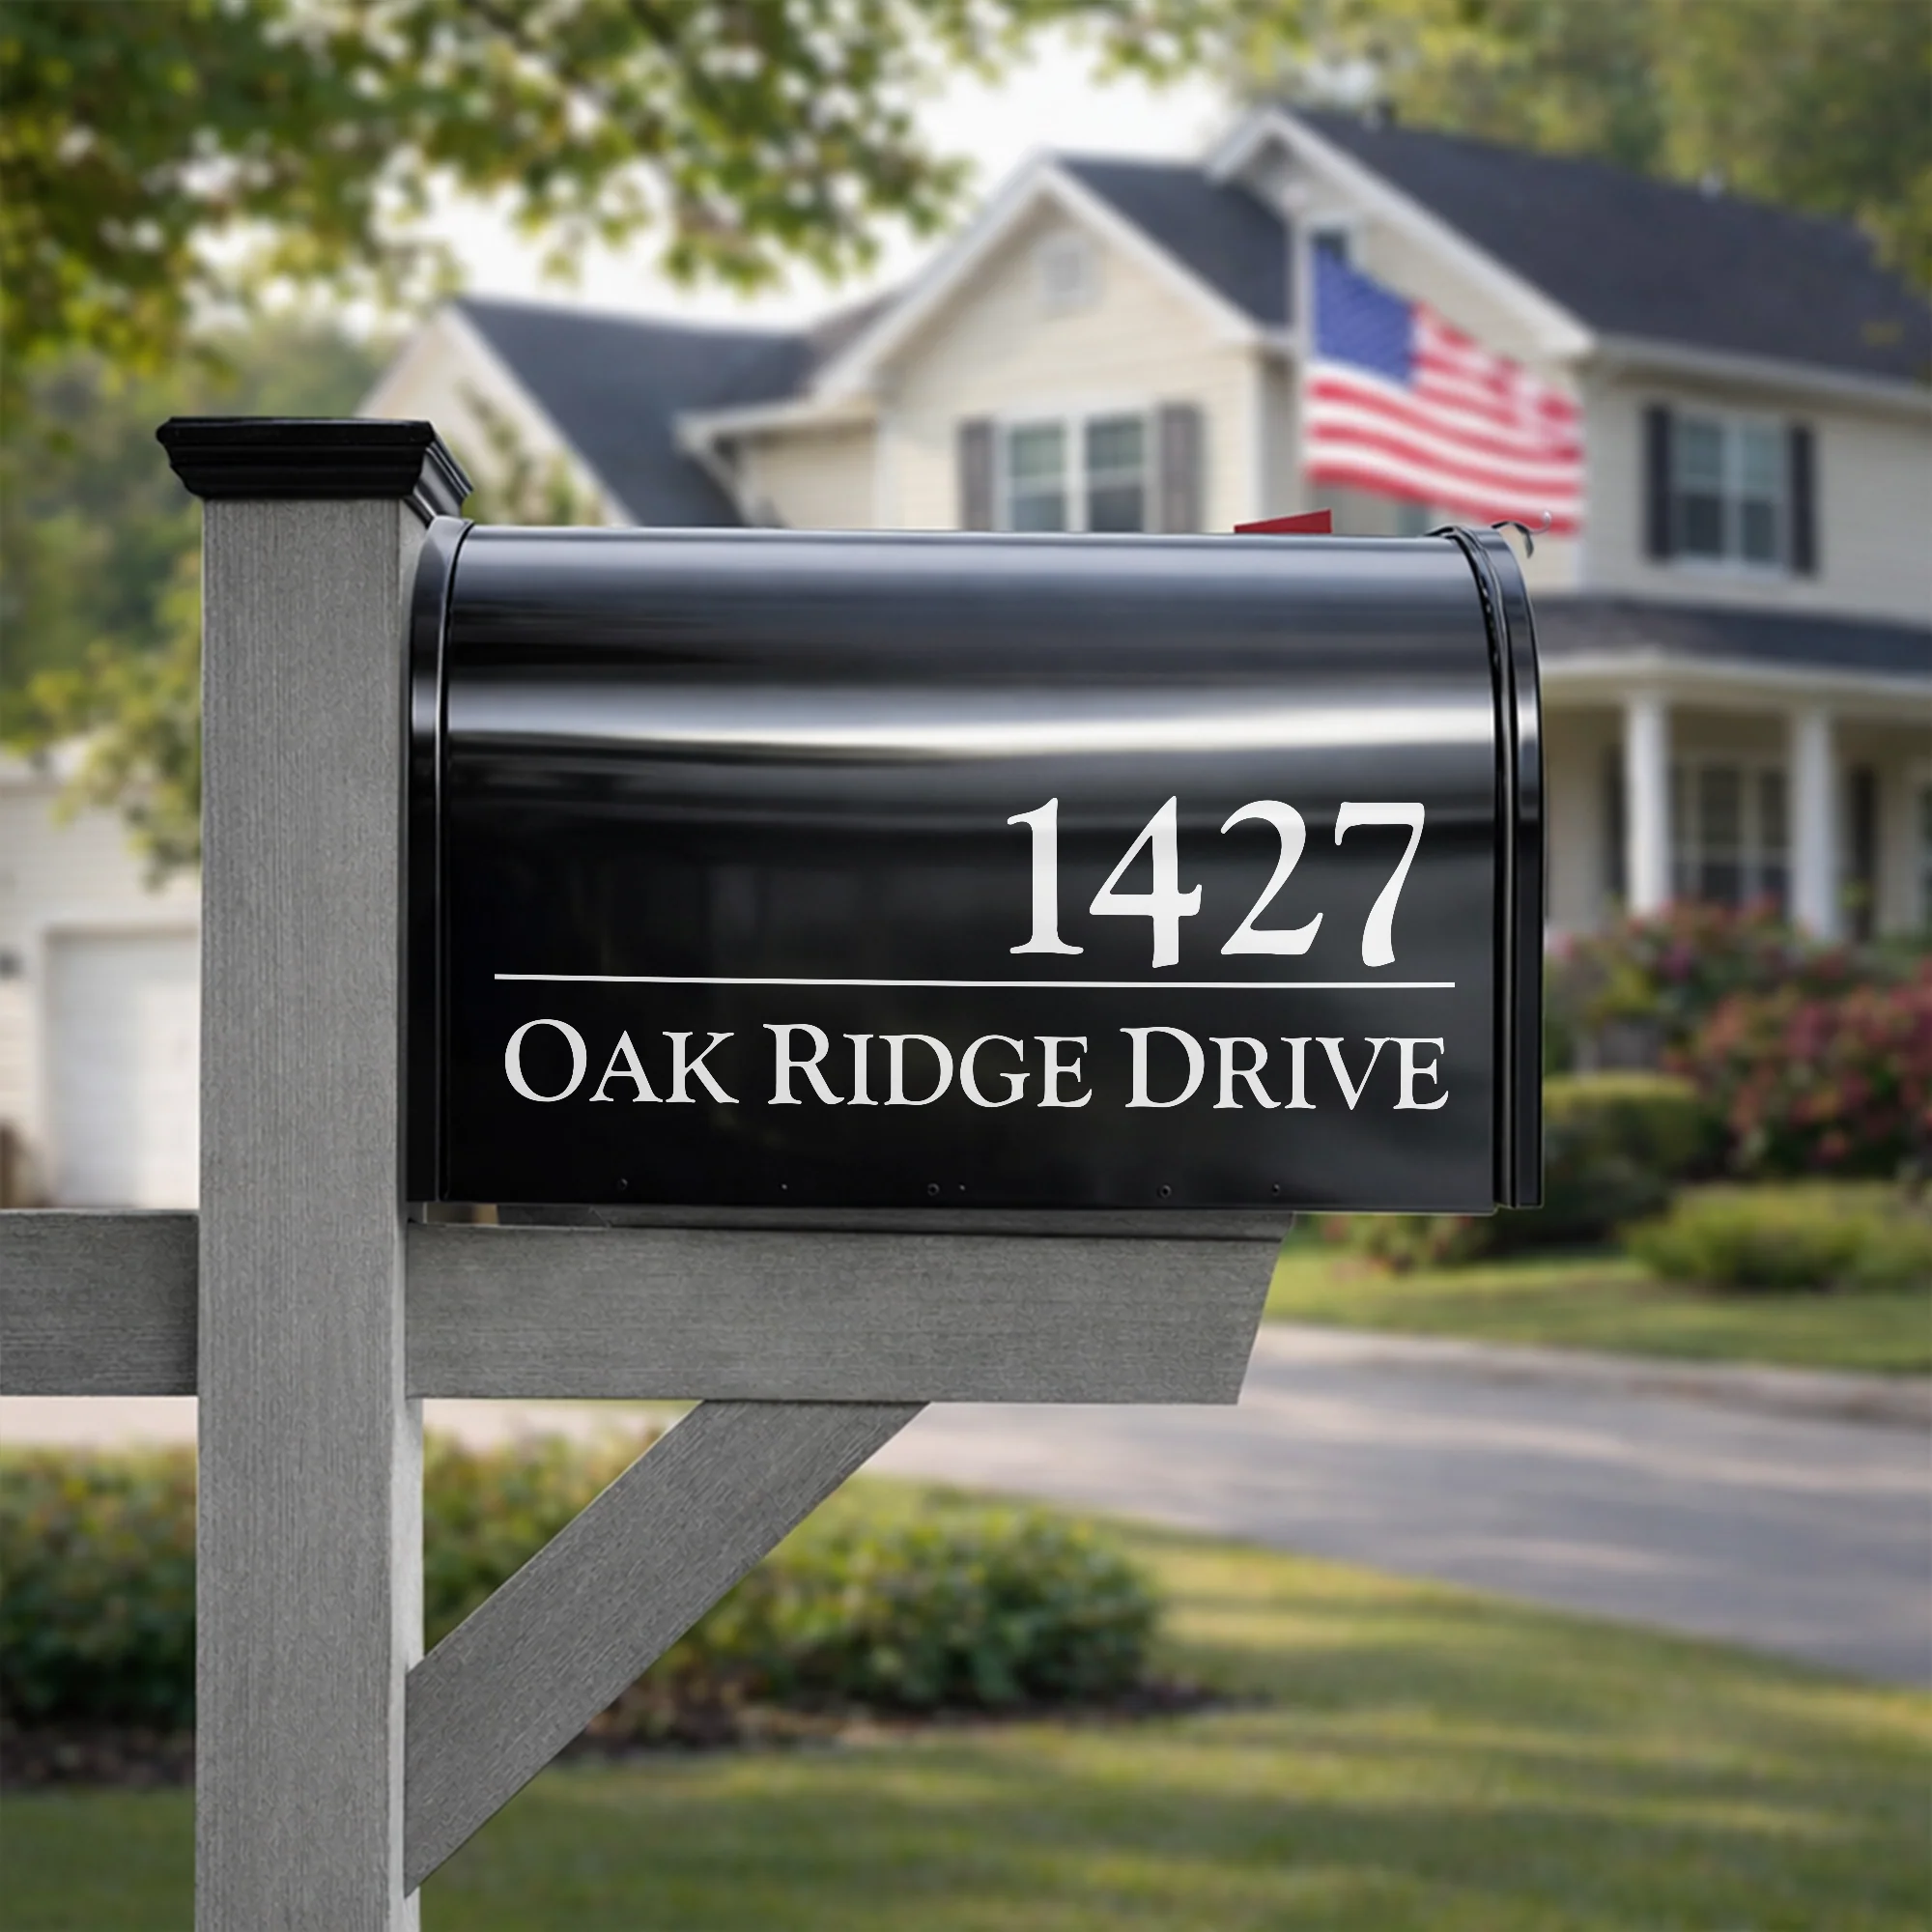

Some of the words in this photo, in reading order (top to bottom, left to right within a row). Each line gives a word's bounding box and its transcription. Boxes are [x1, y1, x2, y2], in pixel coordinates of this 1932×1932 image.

[1007, 795, 1426, 969] 1427
[504, 1018, 740, 1104] OAK
[762, 1023, 1093, 1108] RIDGE
[1119, 1026, 1449, 1111] DRIVE
